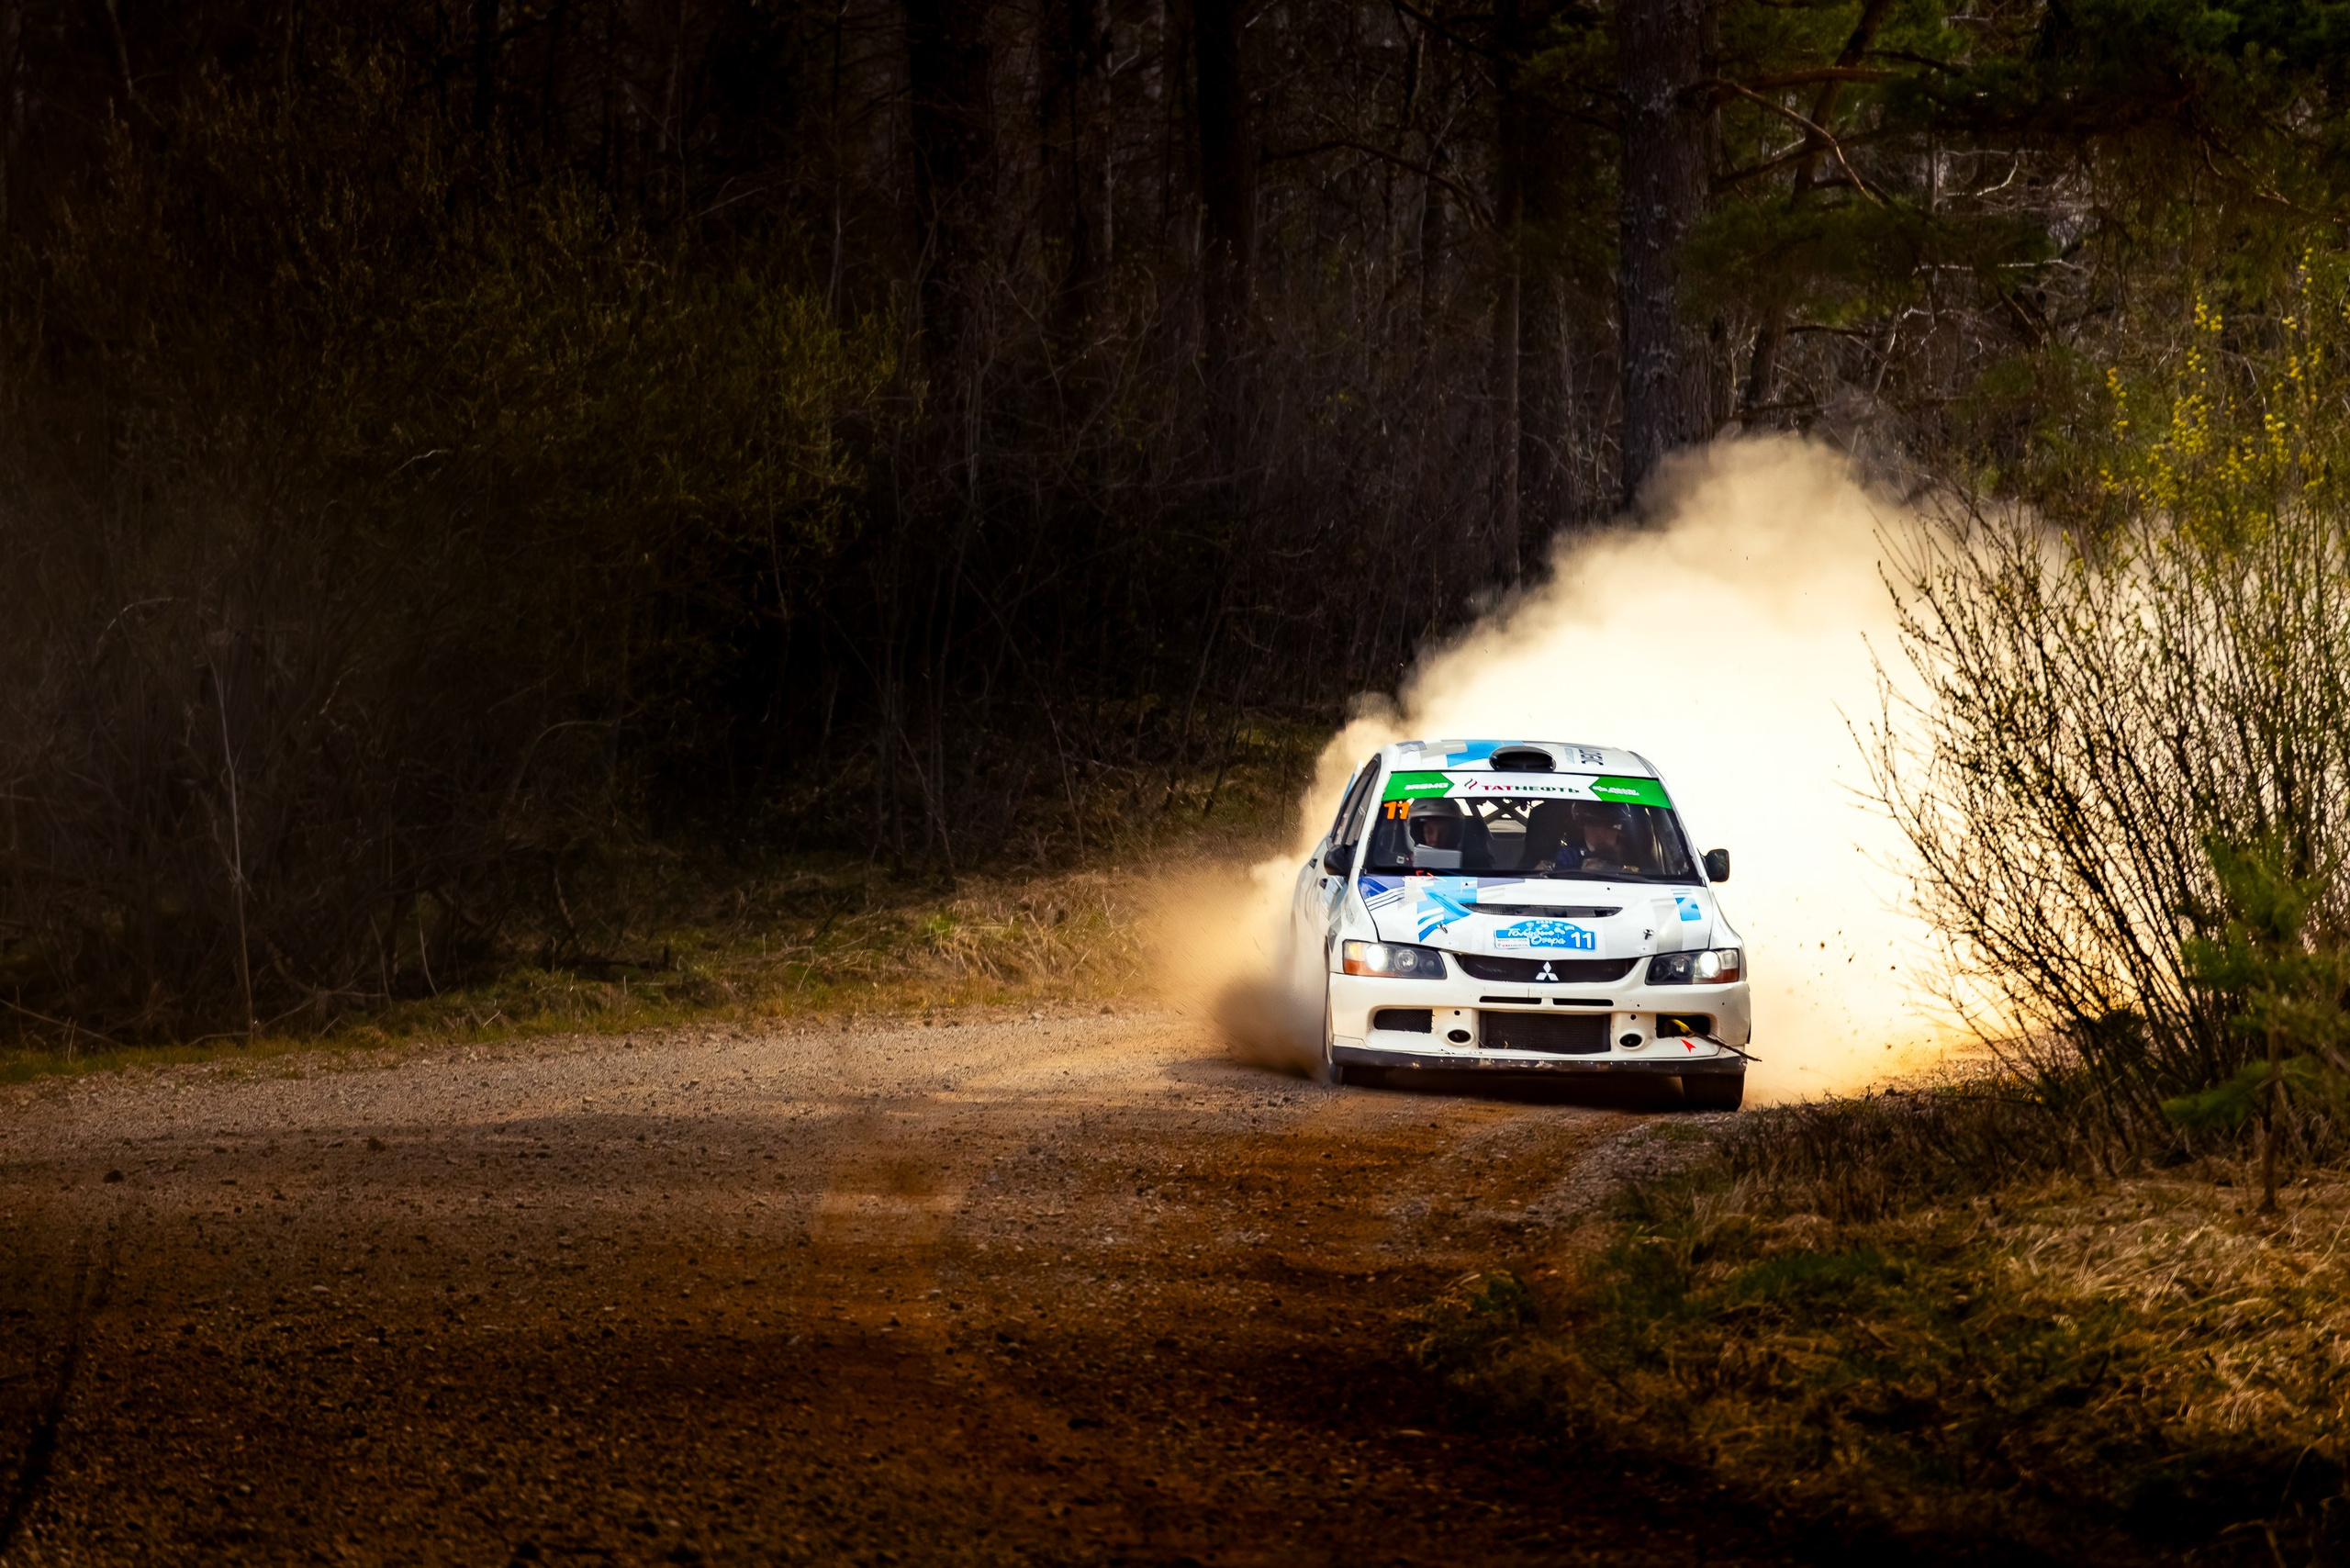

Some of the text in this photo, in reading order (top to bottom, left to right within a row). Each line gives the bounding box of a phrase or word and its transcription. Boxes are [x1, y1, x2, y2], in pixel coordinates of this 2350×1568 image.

[1481, 785, 1580, 793] ТАТНЕФТЬ
[1383, 801, 1410, 820] 11
[1571, 932, 1592, 948] 11
